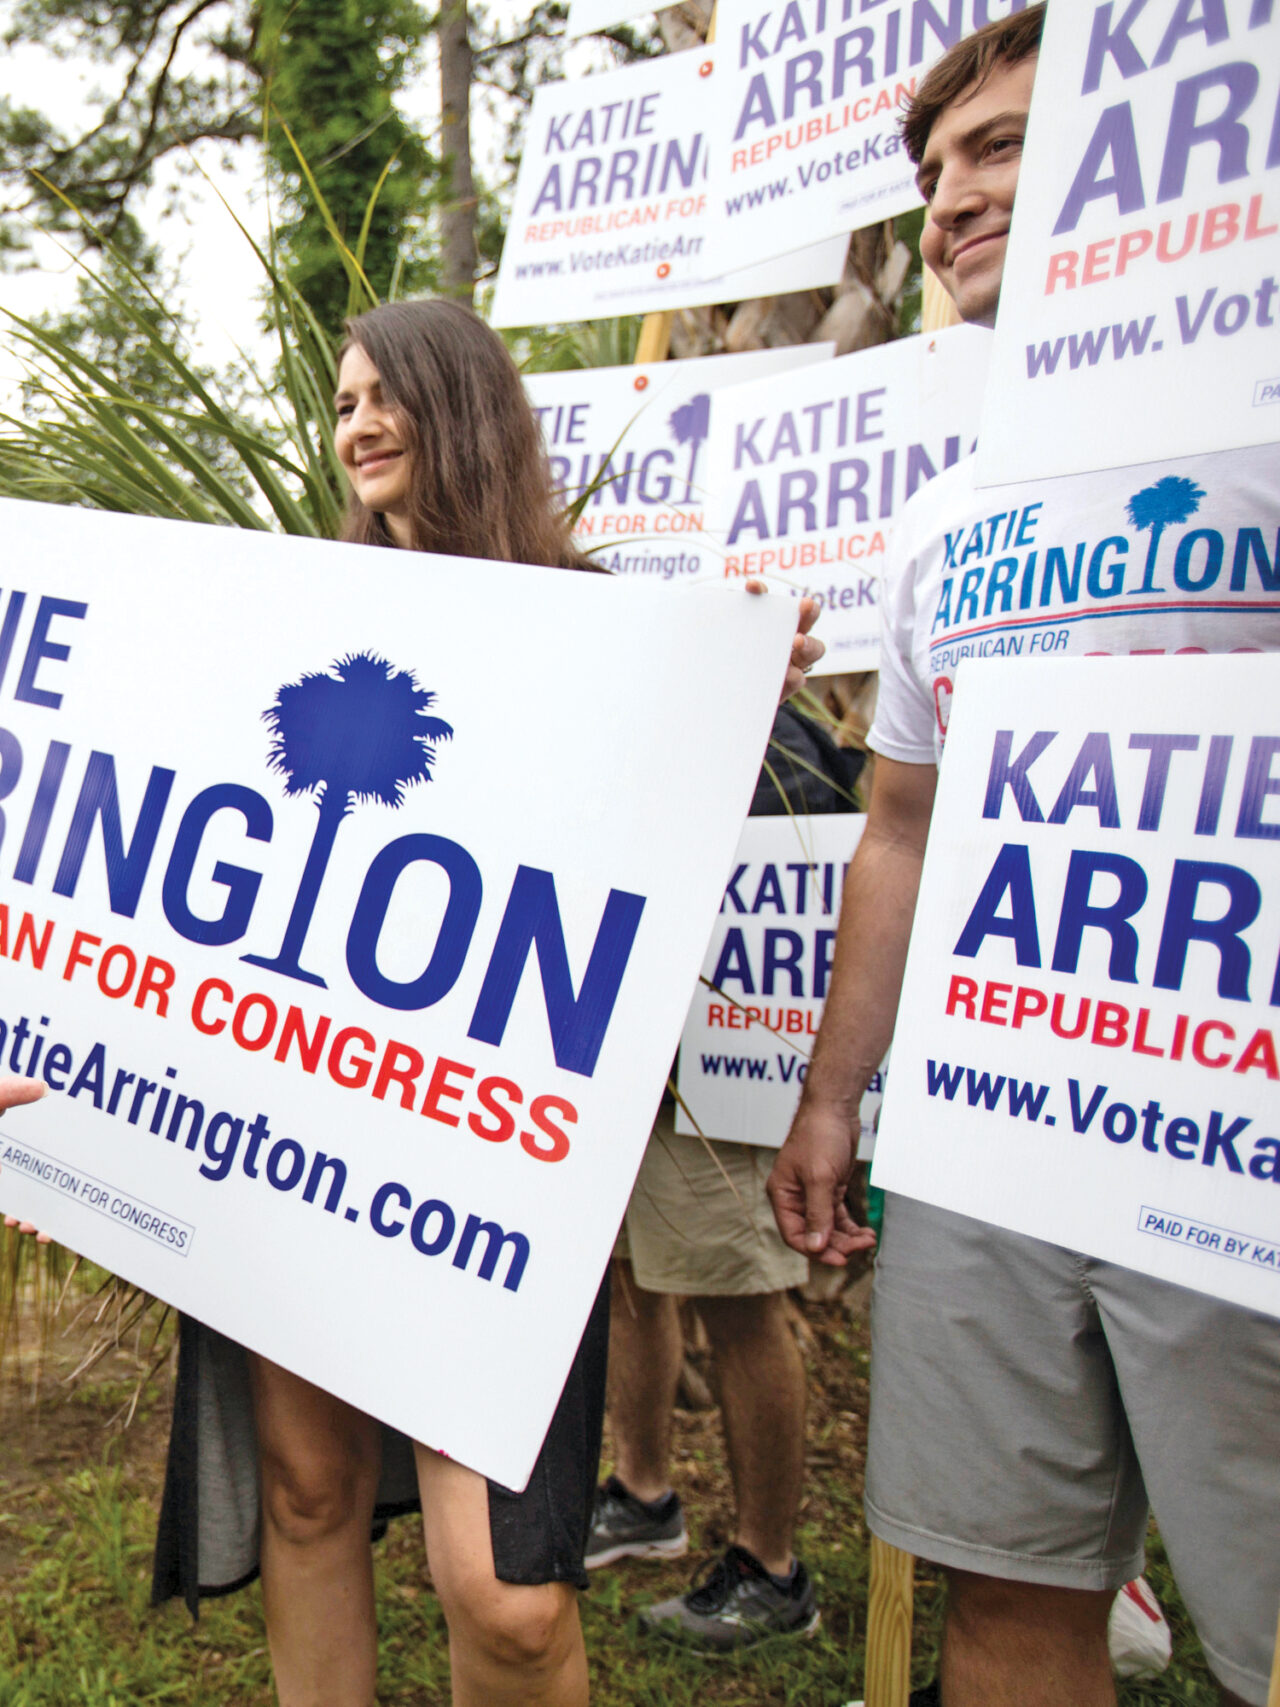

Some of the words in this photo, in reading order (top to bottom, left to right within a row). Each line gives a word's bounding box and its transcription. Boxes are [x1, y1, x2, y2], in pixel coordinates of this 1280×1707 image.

[543, 92, 661, 156] KATIE
[731, 77, 917, 174] REPUBLICAN
[1051, 61, 1280, 236] AR
[530, 131, 709, 217] ARRIN
[724, 131, 904, 218] www.VoteKa
[524, 204, 658, 244] REPUBLICAN
[733, 387, 887, 470] KATIE
[601, 514, 646, 535] FOR
[726, 435, 978, 545] ARRIN
[724, 529, 888, 579] REPUBLICA
[941, 502, 1043, 573] KATIE
[1030, 630, 1070, 659] FOR
[720, 863, 851, 915] KATI
[62, 929, 176, 1019] FOR
[190, 977, 580, 1164] CONGRESS
[2, 1146, 81, 1194] ARRINGTON
[81, 1183, 111, 1213] FOR
[109, 1198, 189, 1250] CONGRESS
[1145, 1214, 1183, 1237] PAID
[1186, 1226, 1221, 1249] FOR
[1224, 1237, 1250, 1256] BY
